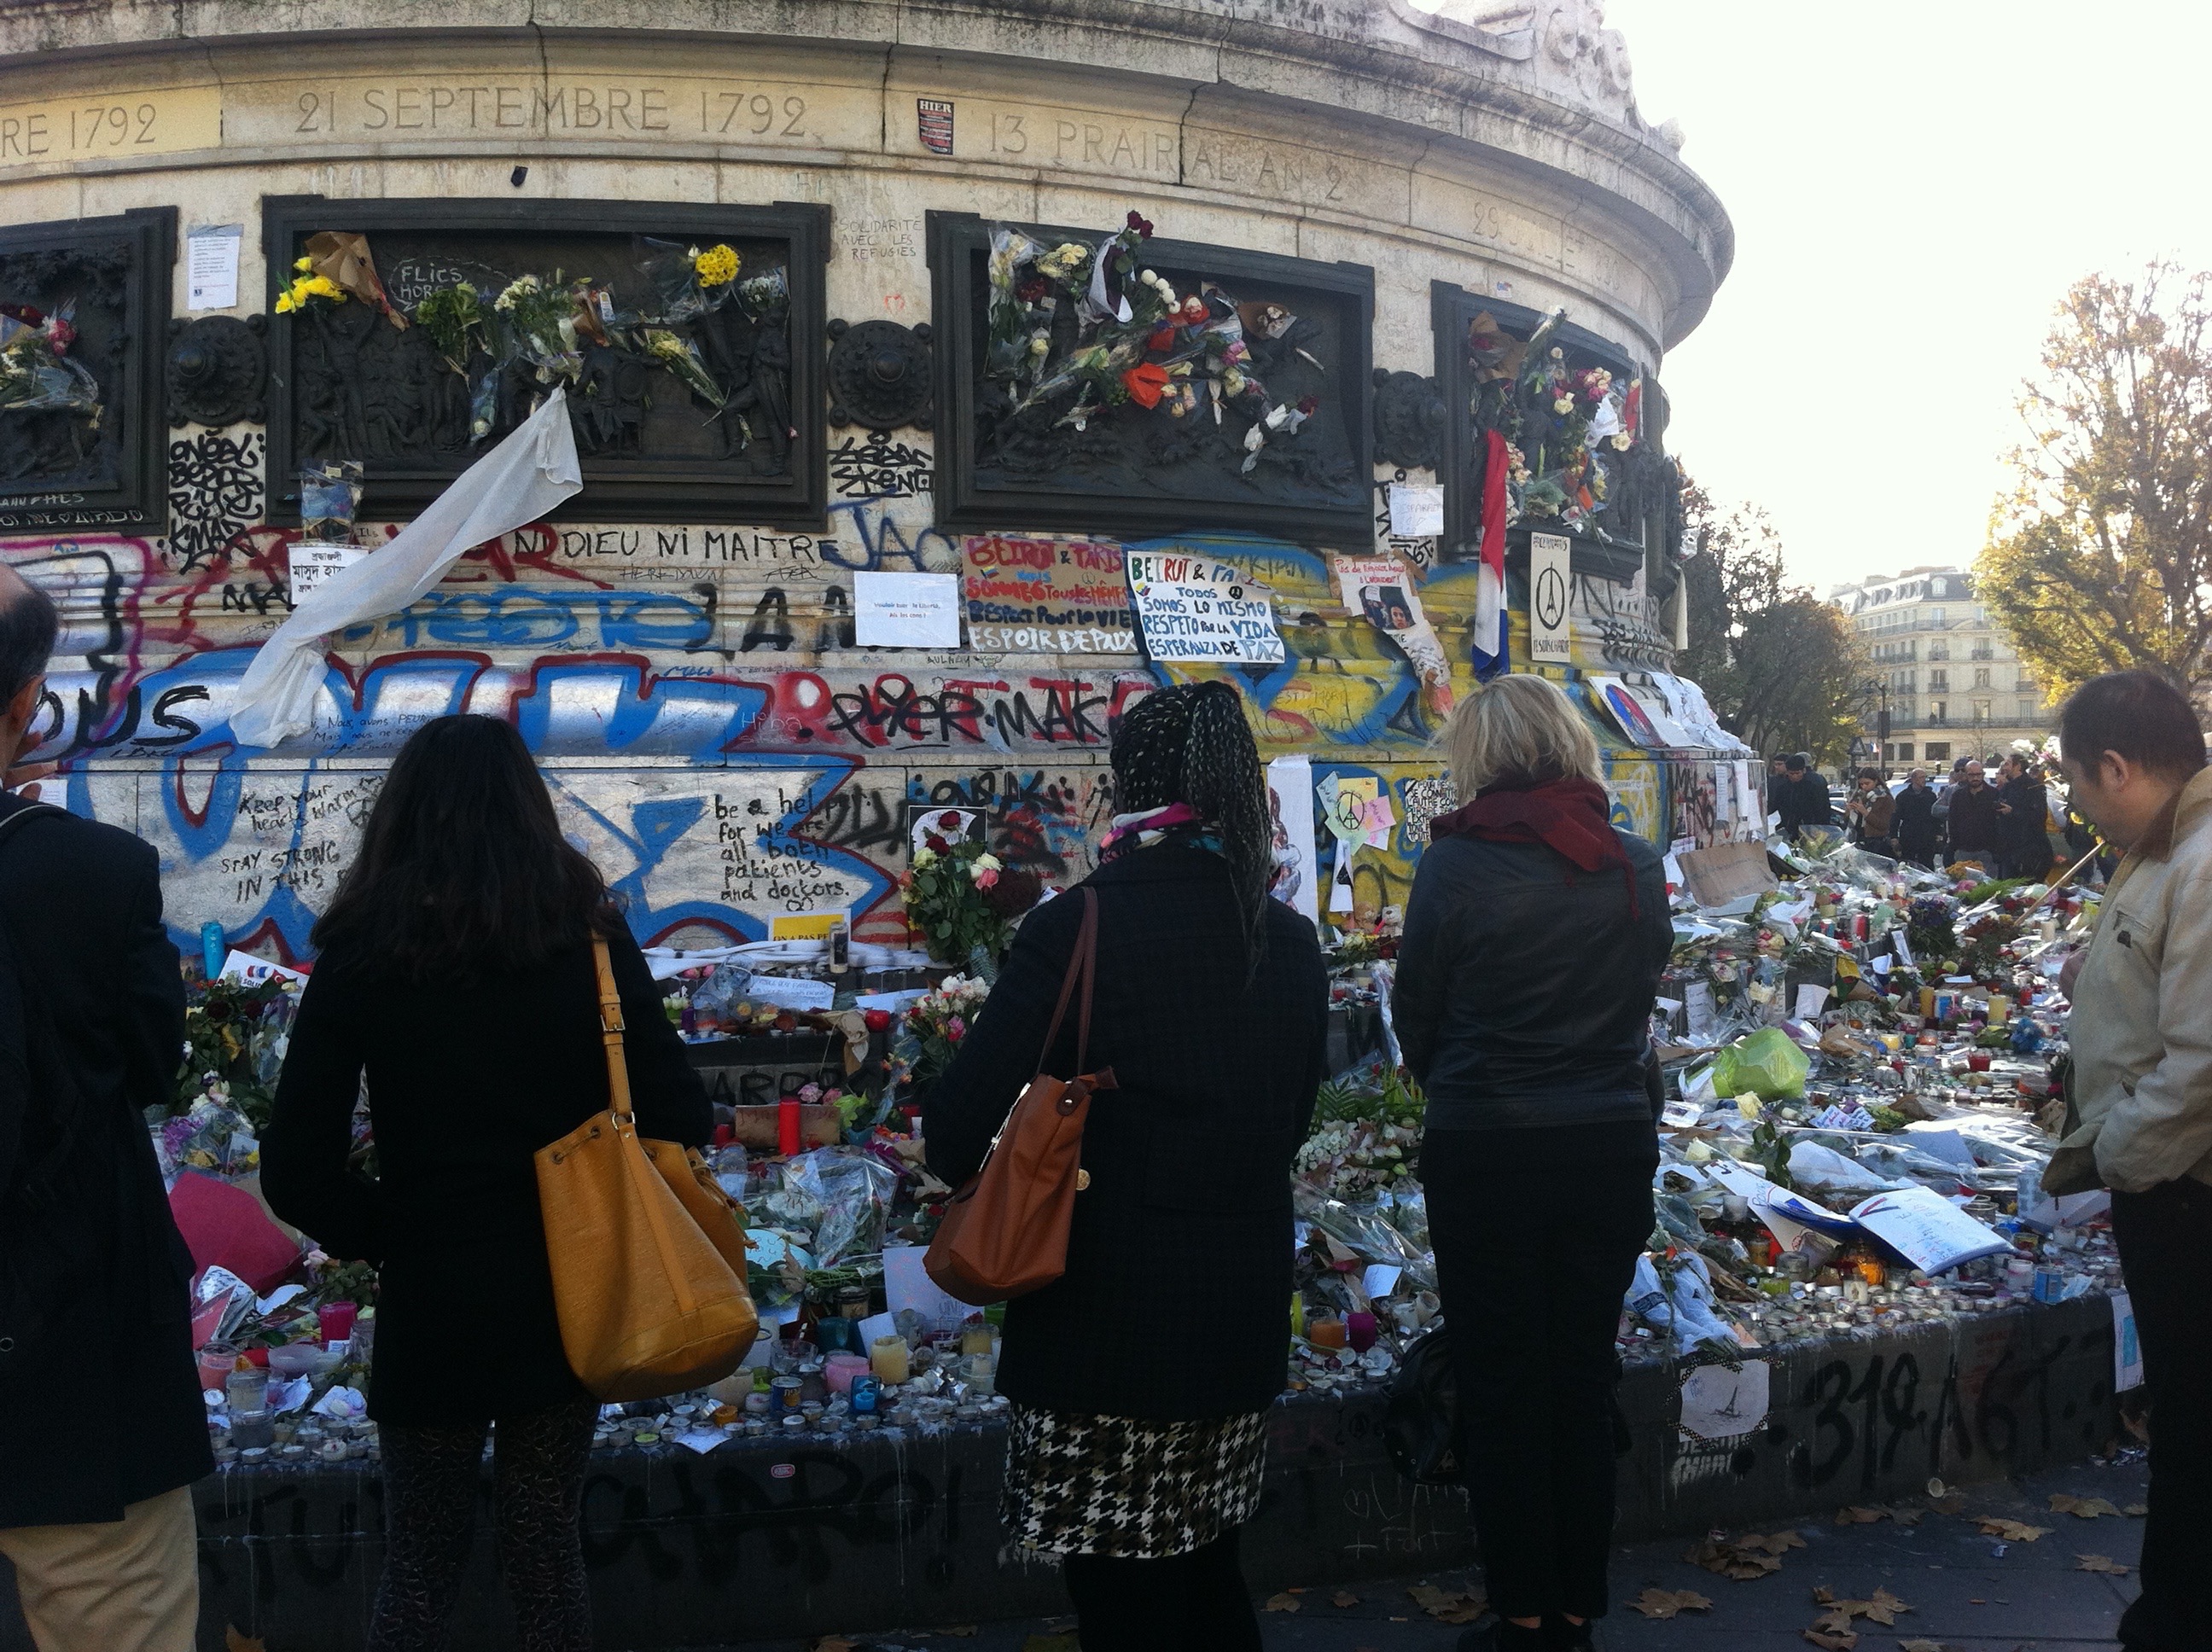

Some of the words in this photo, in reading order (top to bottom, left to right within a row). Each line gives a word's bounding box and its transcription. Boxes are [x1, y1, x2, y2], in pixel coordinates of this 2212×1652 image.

[294, 91, 336, 133] 21
[363, 87, 670, 131] SEPTEMBRE
[701, 90, 807, 138] 1792
[919, 100, 952, 113] HIER
[70, 103, 157, 148] 1792
[990, 113, 1027, 154] 13
[1255, 155, 1307, 193] AN
[1324, 168, 1347, 202] 2
[838, 216, 923, 233] SOLIDARITÉ
[1472, 201, 1500, 240] 29
[841, 235, 877, 246] AVEC
[894, 234, 913, 246] LES
[851, 247, 917, 260] REFUGIES
[562, 529, 640, 558] DIEU
[1060, 550, 1072, 565] &
[1132, 556, 1192, 584] BEIRUT
[1193, 563, 1206, 581] &
[1175, 587, 1219, 599] TODOS
[1096, 609, 1132, 629] VIE
[1143, 599, 1187, 614] SOMOS
[1194, 601, 1211, 614] LO
[1216, 601, 1267, 617] MISMO
[1142, 614, 1199, 637] RESPETO
[1217, 623, 1231, 635] LA
[1230, 619, 1280, 639] VIDA
[967, 626, 1058, 652] ESPOIR
[1057, 629, 1092, 653] DE
[1148, 639, 1221, 658] ESPERANZA
[1220, 640, 1241, 657] DE
[1239, 640, 1284, 661] PAZ
[714, 794, 739, 820] be
[748, 799, 769, 816] a
[719, 822, 747, 843] for
[757, 821, 784, 839] we
[221, 850, 261, 873] STAY
[271, 840, 341, 869] STRONG
[720, 839, 748, 863] all
[725, 858, 823, 889] patients
[236, 875, 262, 904] IN
[720, 881, 758, 901] and
[767, 879, 850, 899] doctors.
